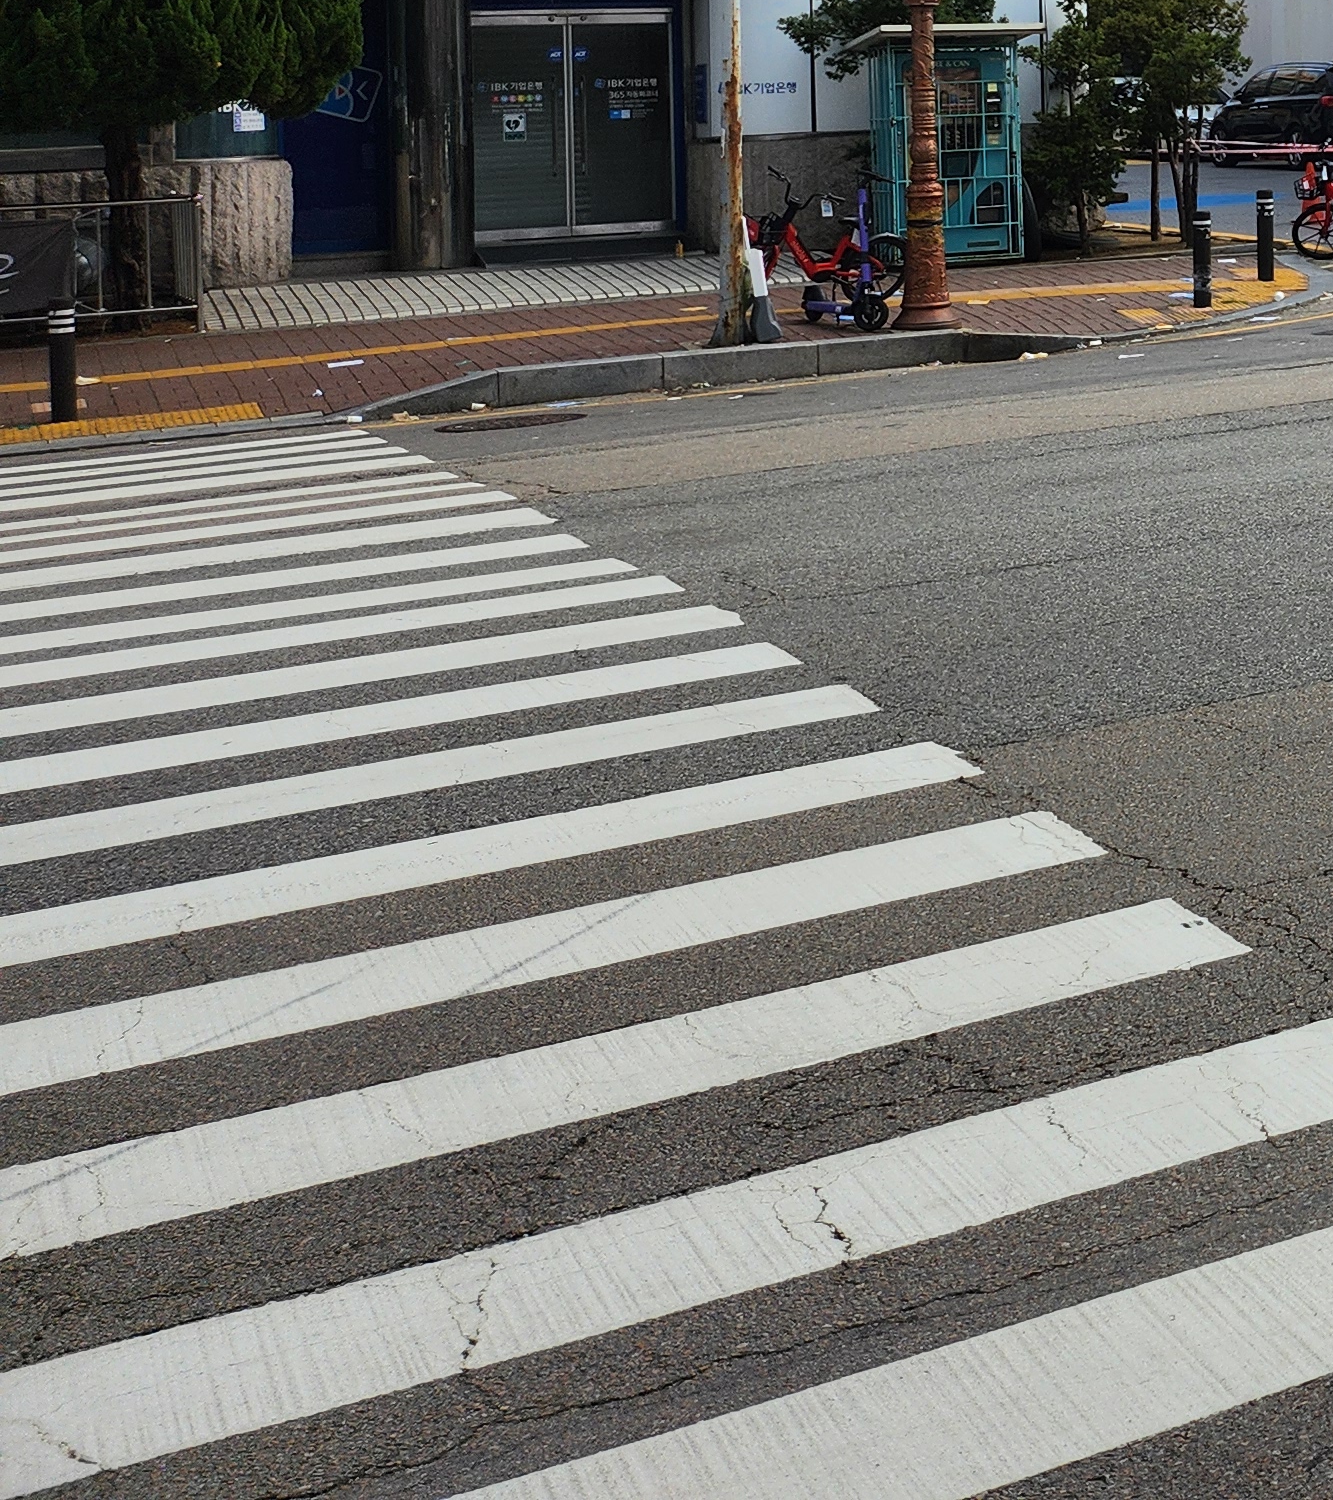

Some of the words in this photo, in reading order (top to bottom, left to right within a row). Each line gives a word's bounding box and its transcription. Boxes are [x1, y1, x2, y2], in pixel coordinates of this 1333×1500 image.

[490, 82, 508, 91] IBK
[509, 82, 543, 91] 기업은행
[607, 78, 625, 88] IBK
[626, 78, 658, 87] 기업은행
[753, 82, 797, 95] 기업은행
